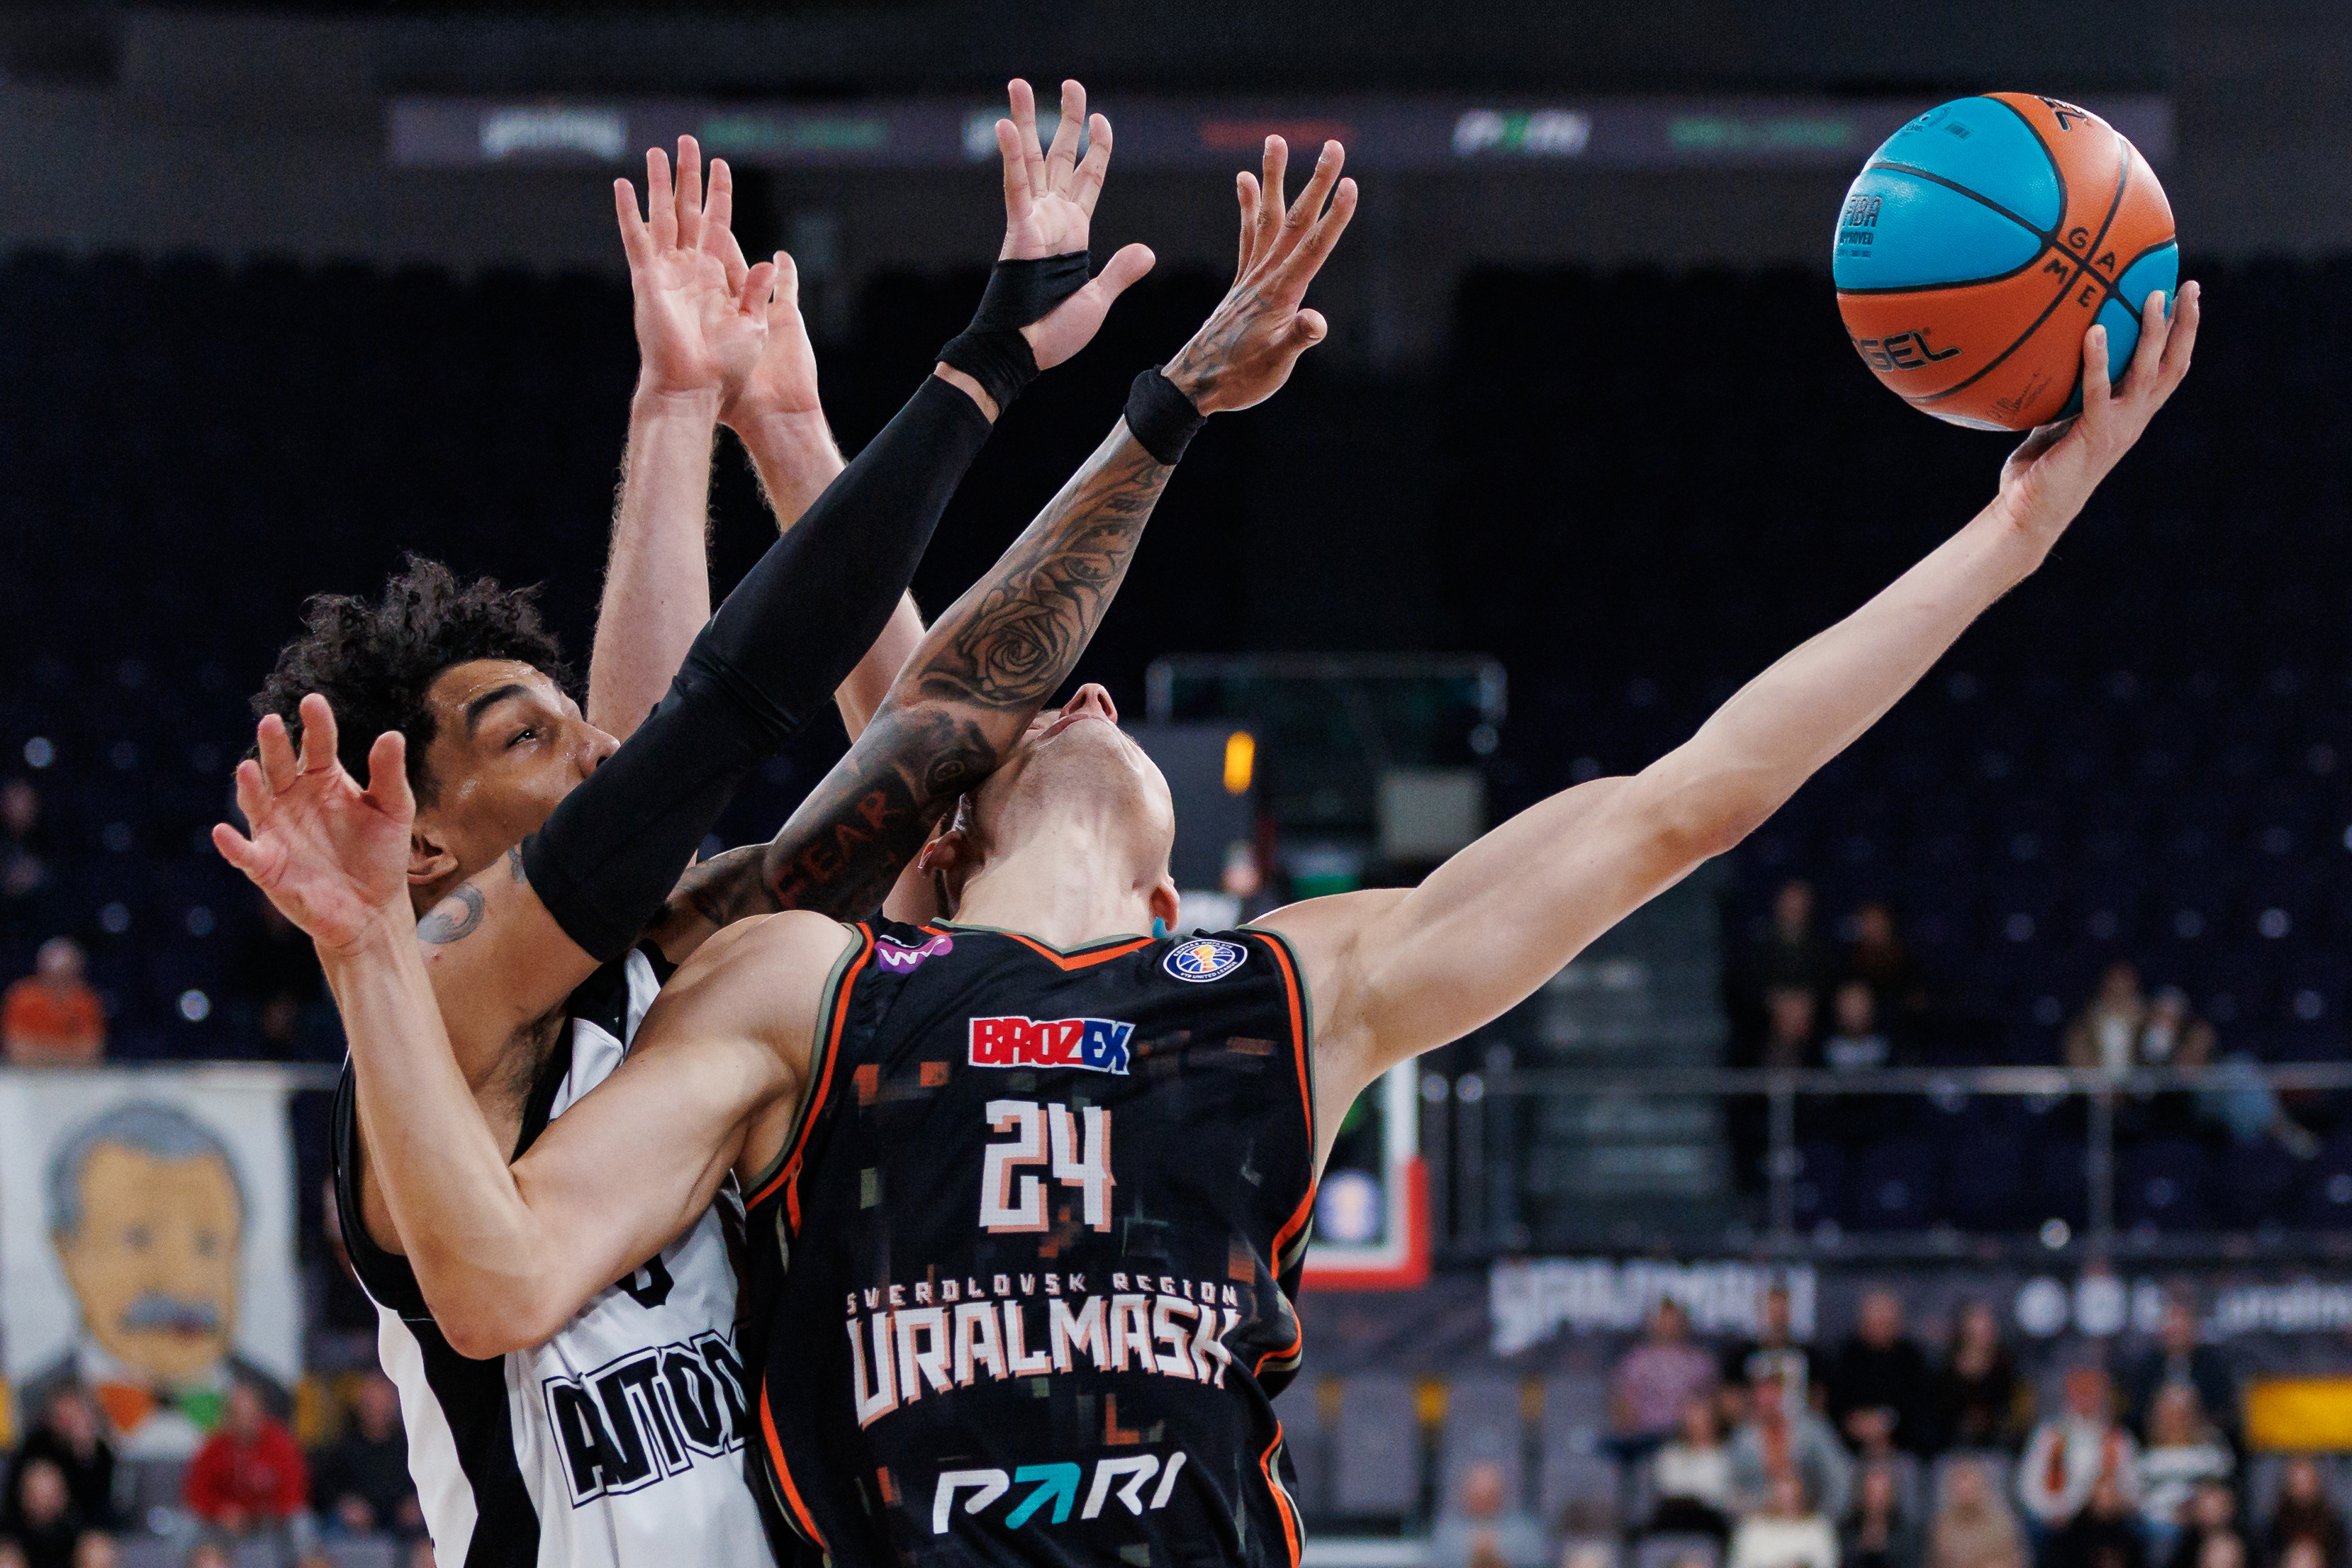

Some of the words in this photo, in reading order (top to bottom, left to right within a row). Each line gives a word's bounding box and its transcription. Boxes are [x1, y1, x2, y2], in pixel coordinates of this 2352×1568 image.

[969, 1017, 1135, 1074] BROZEX
[979, 1099, 1116, 1233] 24
[847, 1273, 1087, 1315] SVERDLOVSK
[1113, 1272, 1238, 1306] REGION
[847, 1294, 1241, 1430] URALMASH
[933, 1451, 1187, 1534] PARI
